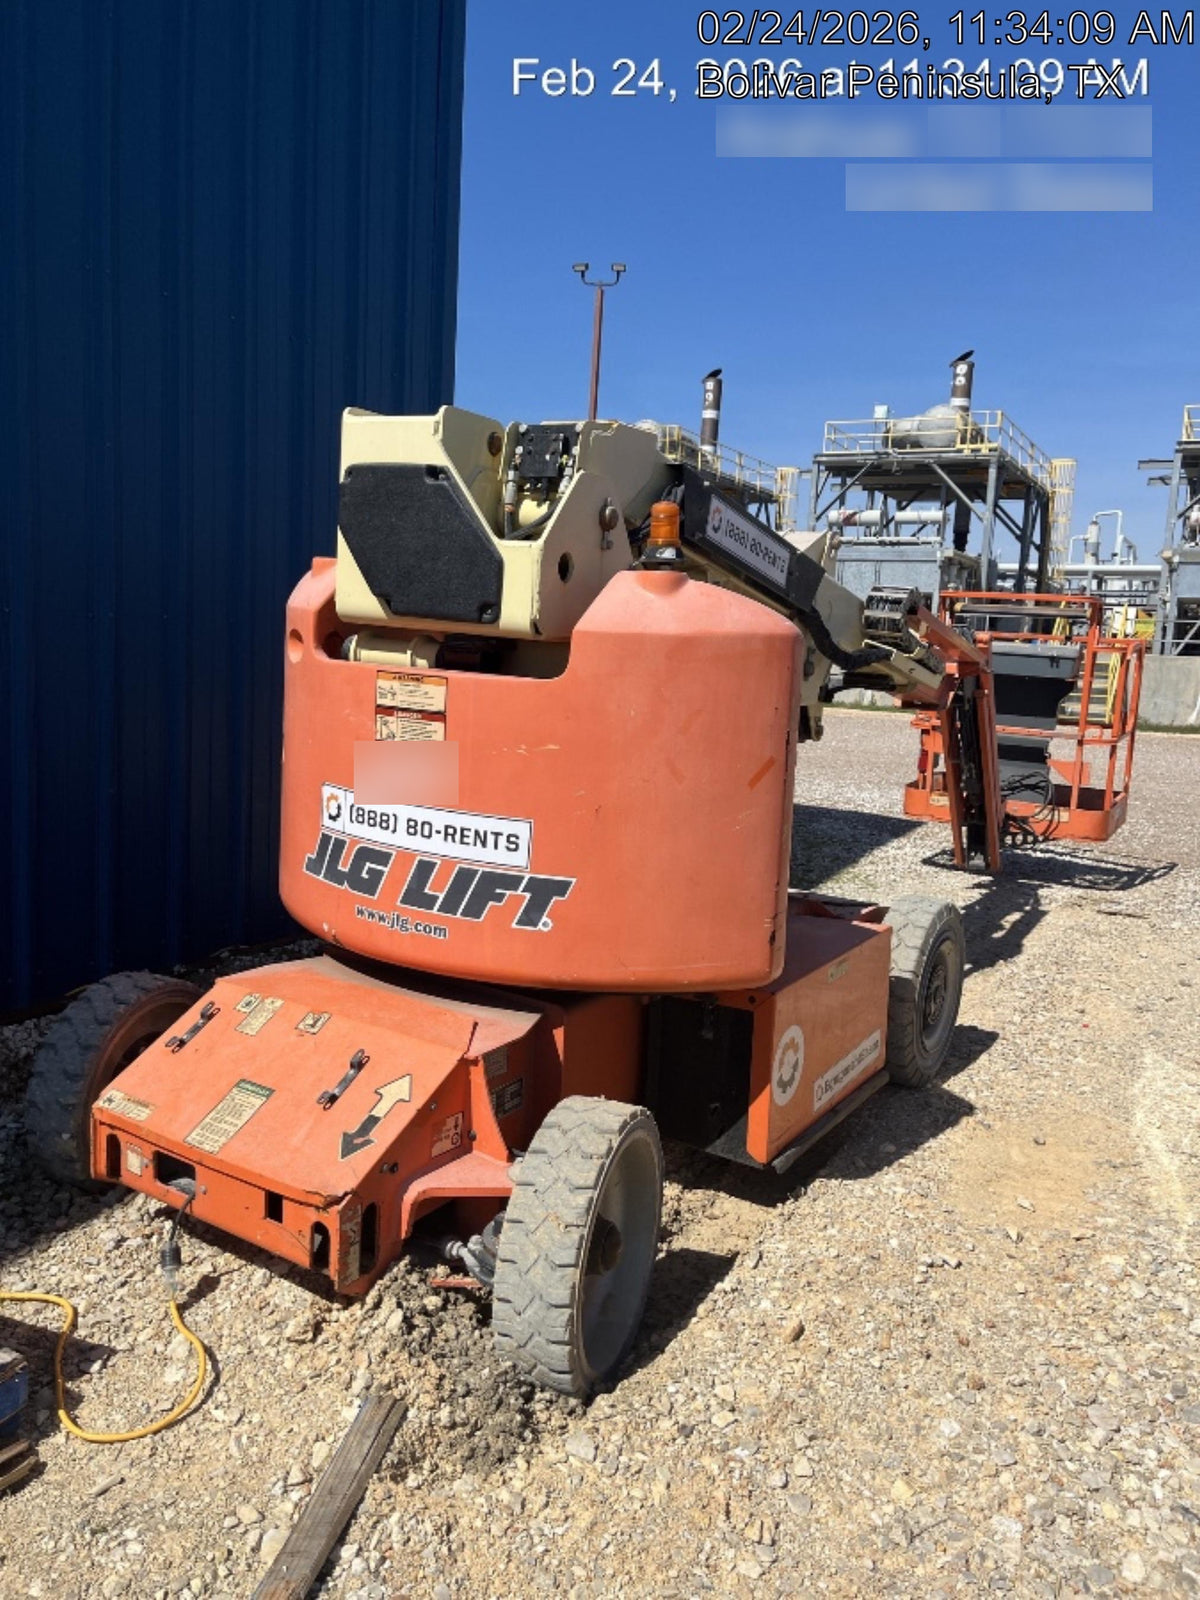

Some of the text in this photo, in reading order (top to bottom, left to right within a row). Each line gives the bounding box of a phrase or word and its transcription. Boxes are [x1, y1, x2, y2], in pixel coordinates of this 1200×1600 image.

[348, 803, 521, 853] (888) 80-RENTS
[303, 832, 577, 931] JLG LIFT
[355, 904, 449, 939] www.jlg.com
